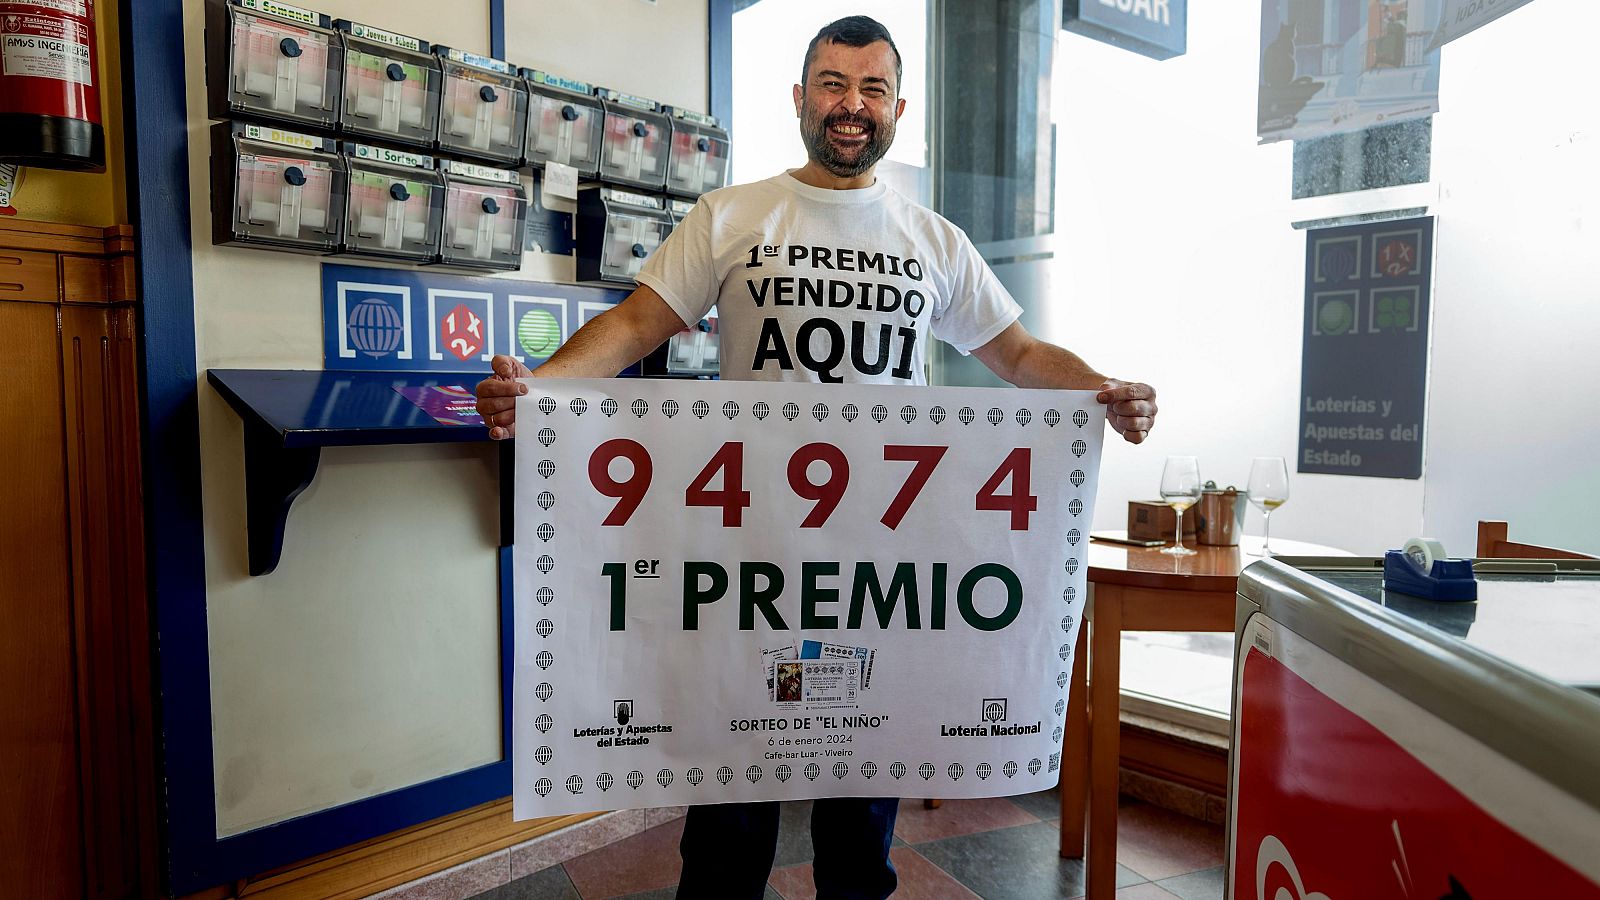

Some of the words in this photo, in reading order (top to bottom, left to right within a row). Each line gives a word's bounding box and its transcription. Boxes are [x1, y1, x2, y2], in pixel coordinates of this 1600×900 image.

[8, 38, 35, 48] AMyS
[366, 28, 387, 42] Jueves
[271, 131, 312, 147] Diario
[375, 149, 380, 159] 1
[385, 151, 417, 166] Sorteo
[478, 168, 504, 179] Gordo
[788, 245, 924, 281] PREMIO
[747, 277, 925, 318] VENDIDO
[752, 317, 917, 384] AQUÍ
[1306, 396, 1376, 413] Loterías
[1382, 400, 1392, 417] y
[1305, 422, 1384, 443] Apuestas
[1391, 424, 1418, 441] del
[1304, 448, 1361, 466] Estado
[588, 438, 1037, 531] 94974
[683, 561, 1023, 631] PREMIO
[574, 726, 615, 737] Loterías
[617, 727, 624, 736] y
[626, 725, 672, 736] Apuestas
[730, 718, 787, 731] SORTEO
[794, 718, 811, 730] DE
[816, 716, 838, 728] "EL
[843, 714, 889, 728] NIÑO"
[941, 725, 987, 736] Lotería
[991, 721, 1041, 736] Nacional
[597, 737, 612, 747] del
[615, 736, 649, 747] Estado
[768, 737, 775, 746] 6
[779, 737, 791, 746] de
[795, 738, 823, 746] enero
[826, 734, 853, 744] 2024
[800, 751, 818, 760] Luar
[825, 749, 853, 758] Viveiro
